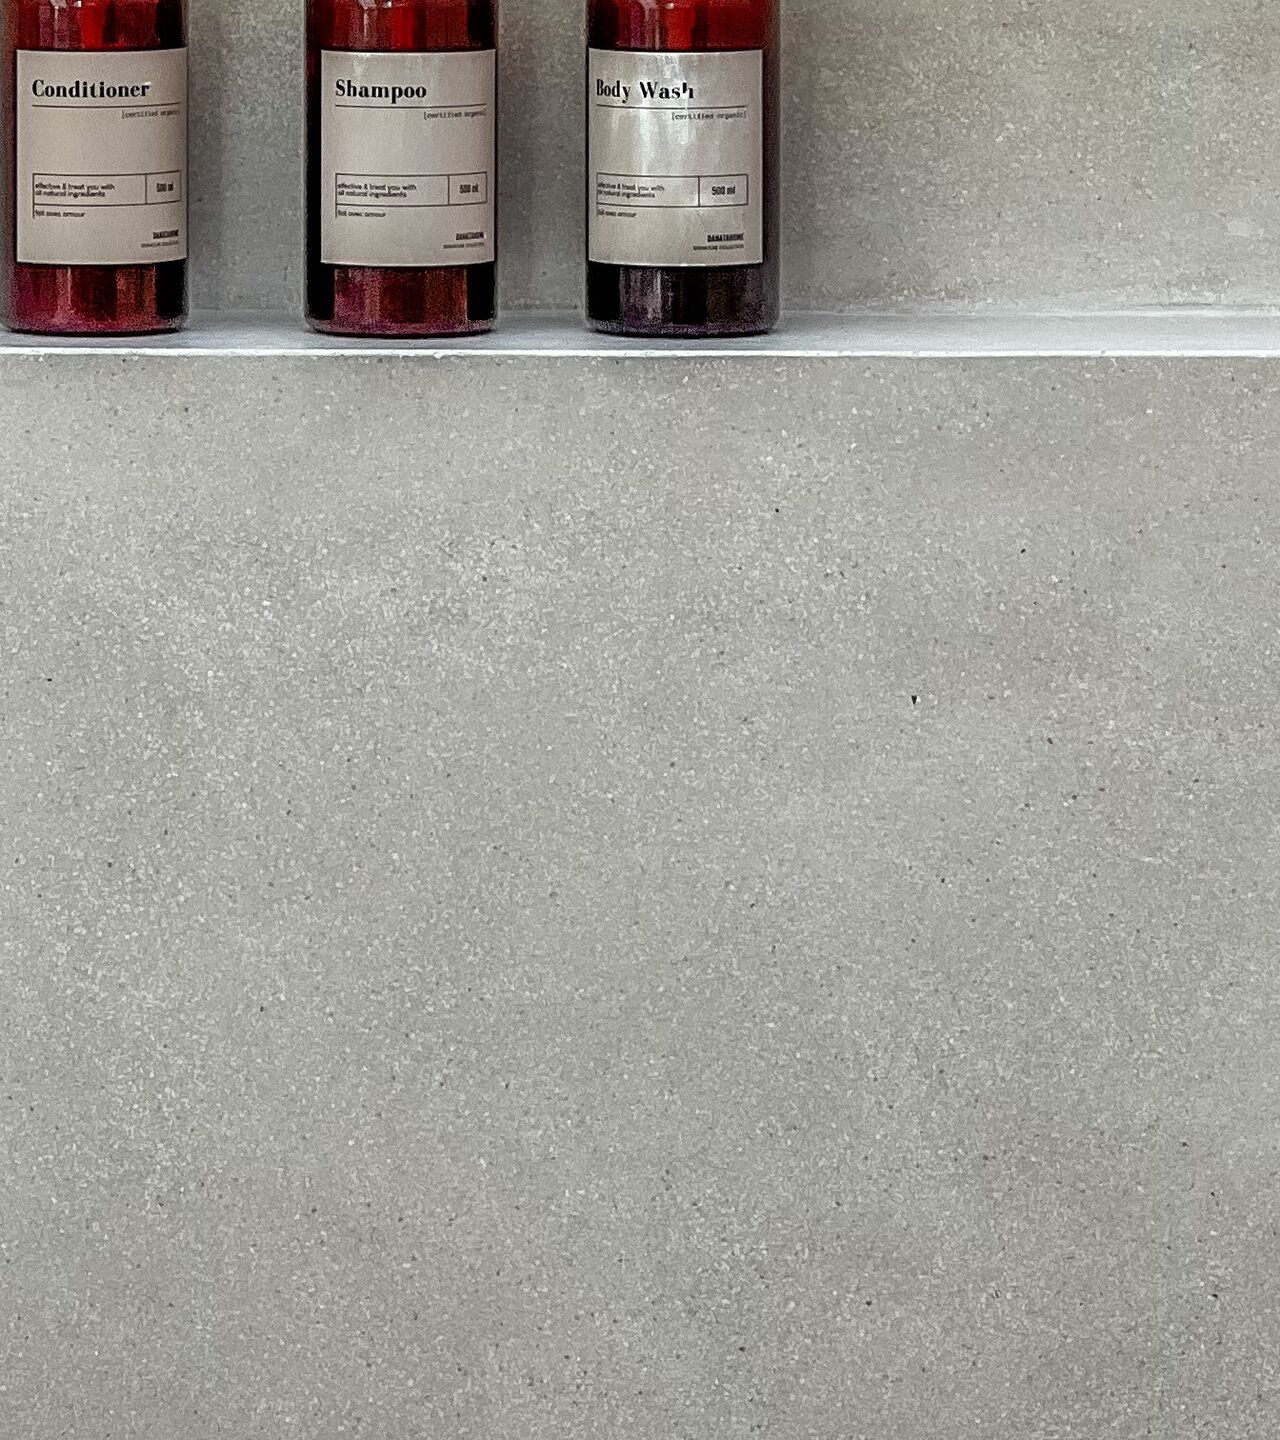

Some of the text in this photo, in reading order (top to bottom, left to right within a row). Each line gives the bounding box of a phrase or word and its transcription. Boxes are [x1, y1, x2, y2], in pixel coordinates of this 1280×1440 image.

[32, 79, 150, 98] Conditioner
[335, 79, 427, 104] Shampoo
[596, 79, 694, 104] Body Wash
